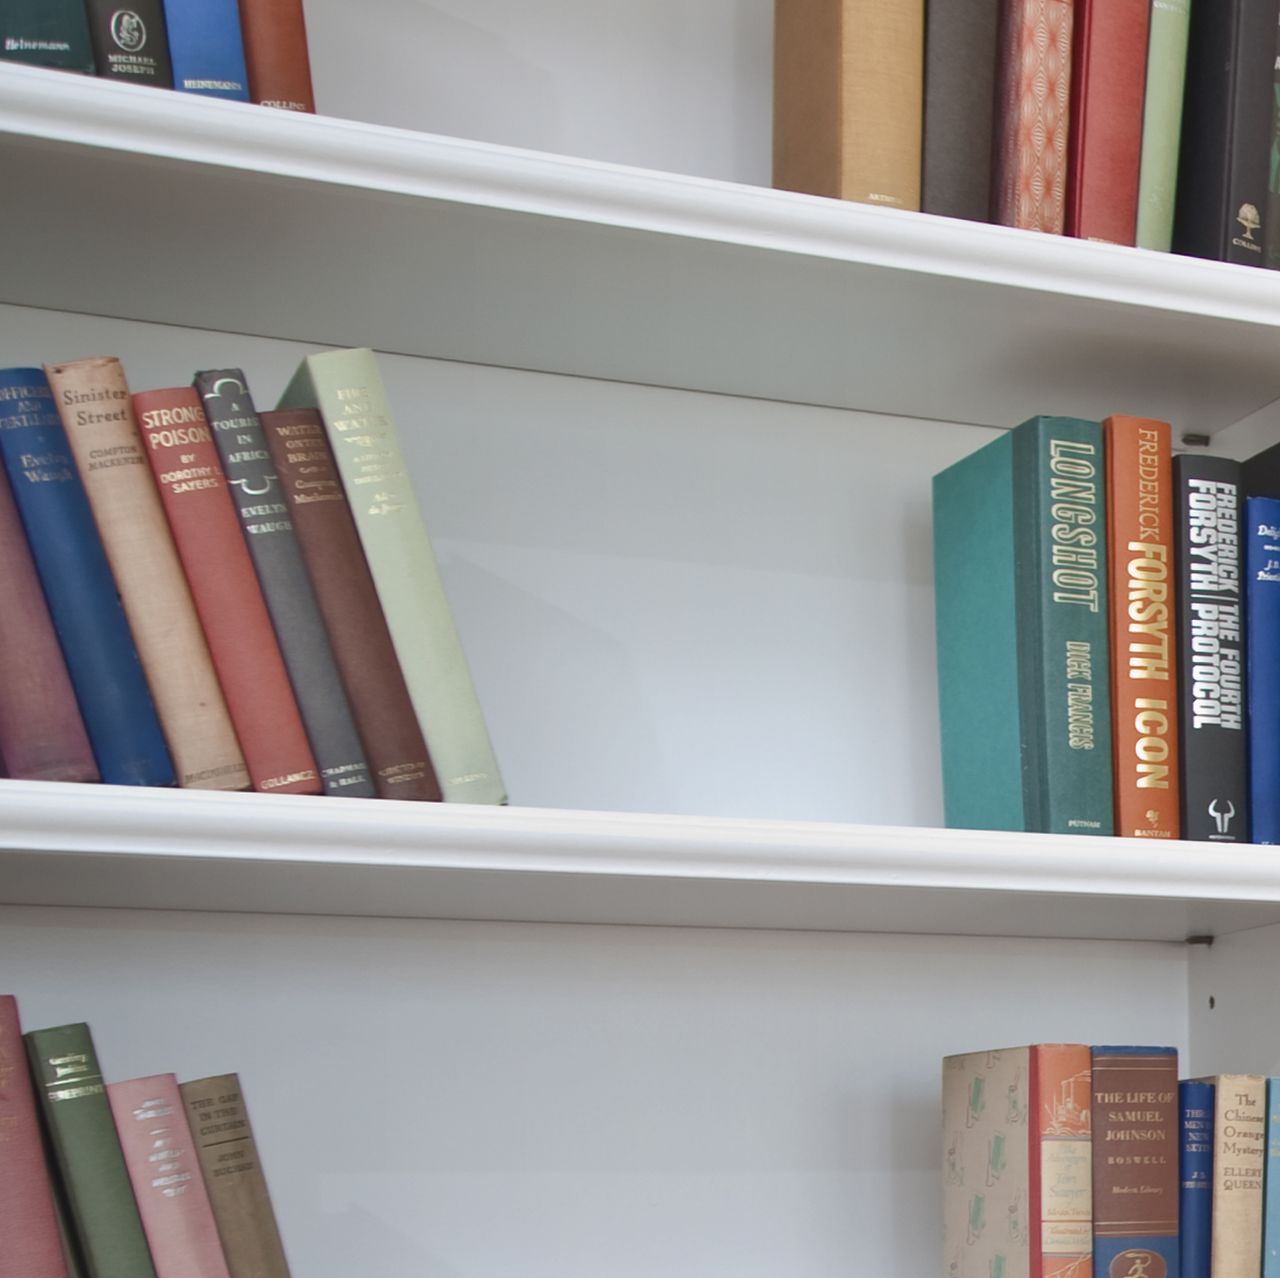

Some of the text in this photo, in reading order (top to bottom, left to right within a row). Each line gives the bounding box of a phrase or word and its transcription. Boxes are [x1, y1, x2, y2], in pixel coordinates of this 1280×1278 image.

[108, 54, 157, 66] MICHAEL
[112, 63, 155, 75] JOSEPH
[63, 387, 128, 406] Sinister
[76, 410, 128, 426] Street
[141, 407, 205, 429] STRONG
[150, 427, 210, 450] POISON
[237, 434, 253, 445] IN
[179, 453, 196, 464] BY
[160, 466, 212, 484] DOROTHY
[171, 477, 219, 494] SAYERS
[1050, 439, 1099, 613] LONGSHOT
[1127, 427, 1170, 790] FREDERICK FORSYTH ICON
[1188, 478, 1222, 729] FORSYTH PROTOCOL
[1214, 481, 1242, 730] FREDERICK THE FOURTH
[1066, 641, 1094, 751] DICK FRANCIS
[1095, 1092, 1175, 1103] THE LIFE OF
[1234, 1093, 1257, 1106] The
[1109, 1111, 1164, 1122] SAMUEL
[1224, 1109, 1264, 1123] Chinese
[1105, 1130, 1166, 1141] JOHNSON
[1223, 1126, 1264, 1141] Orange
[1223, 1142, 1264, 1158] Mystery
[1108, 1156, 1167, 1165] BOSWELL
[1223, 1179, 1262, 1191] QUEEN
